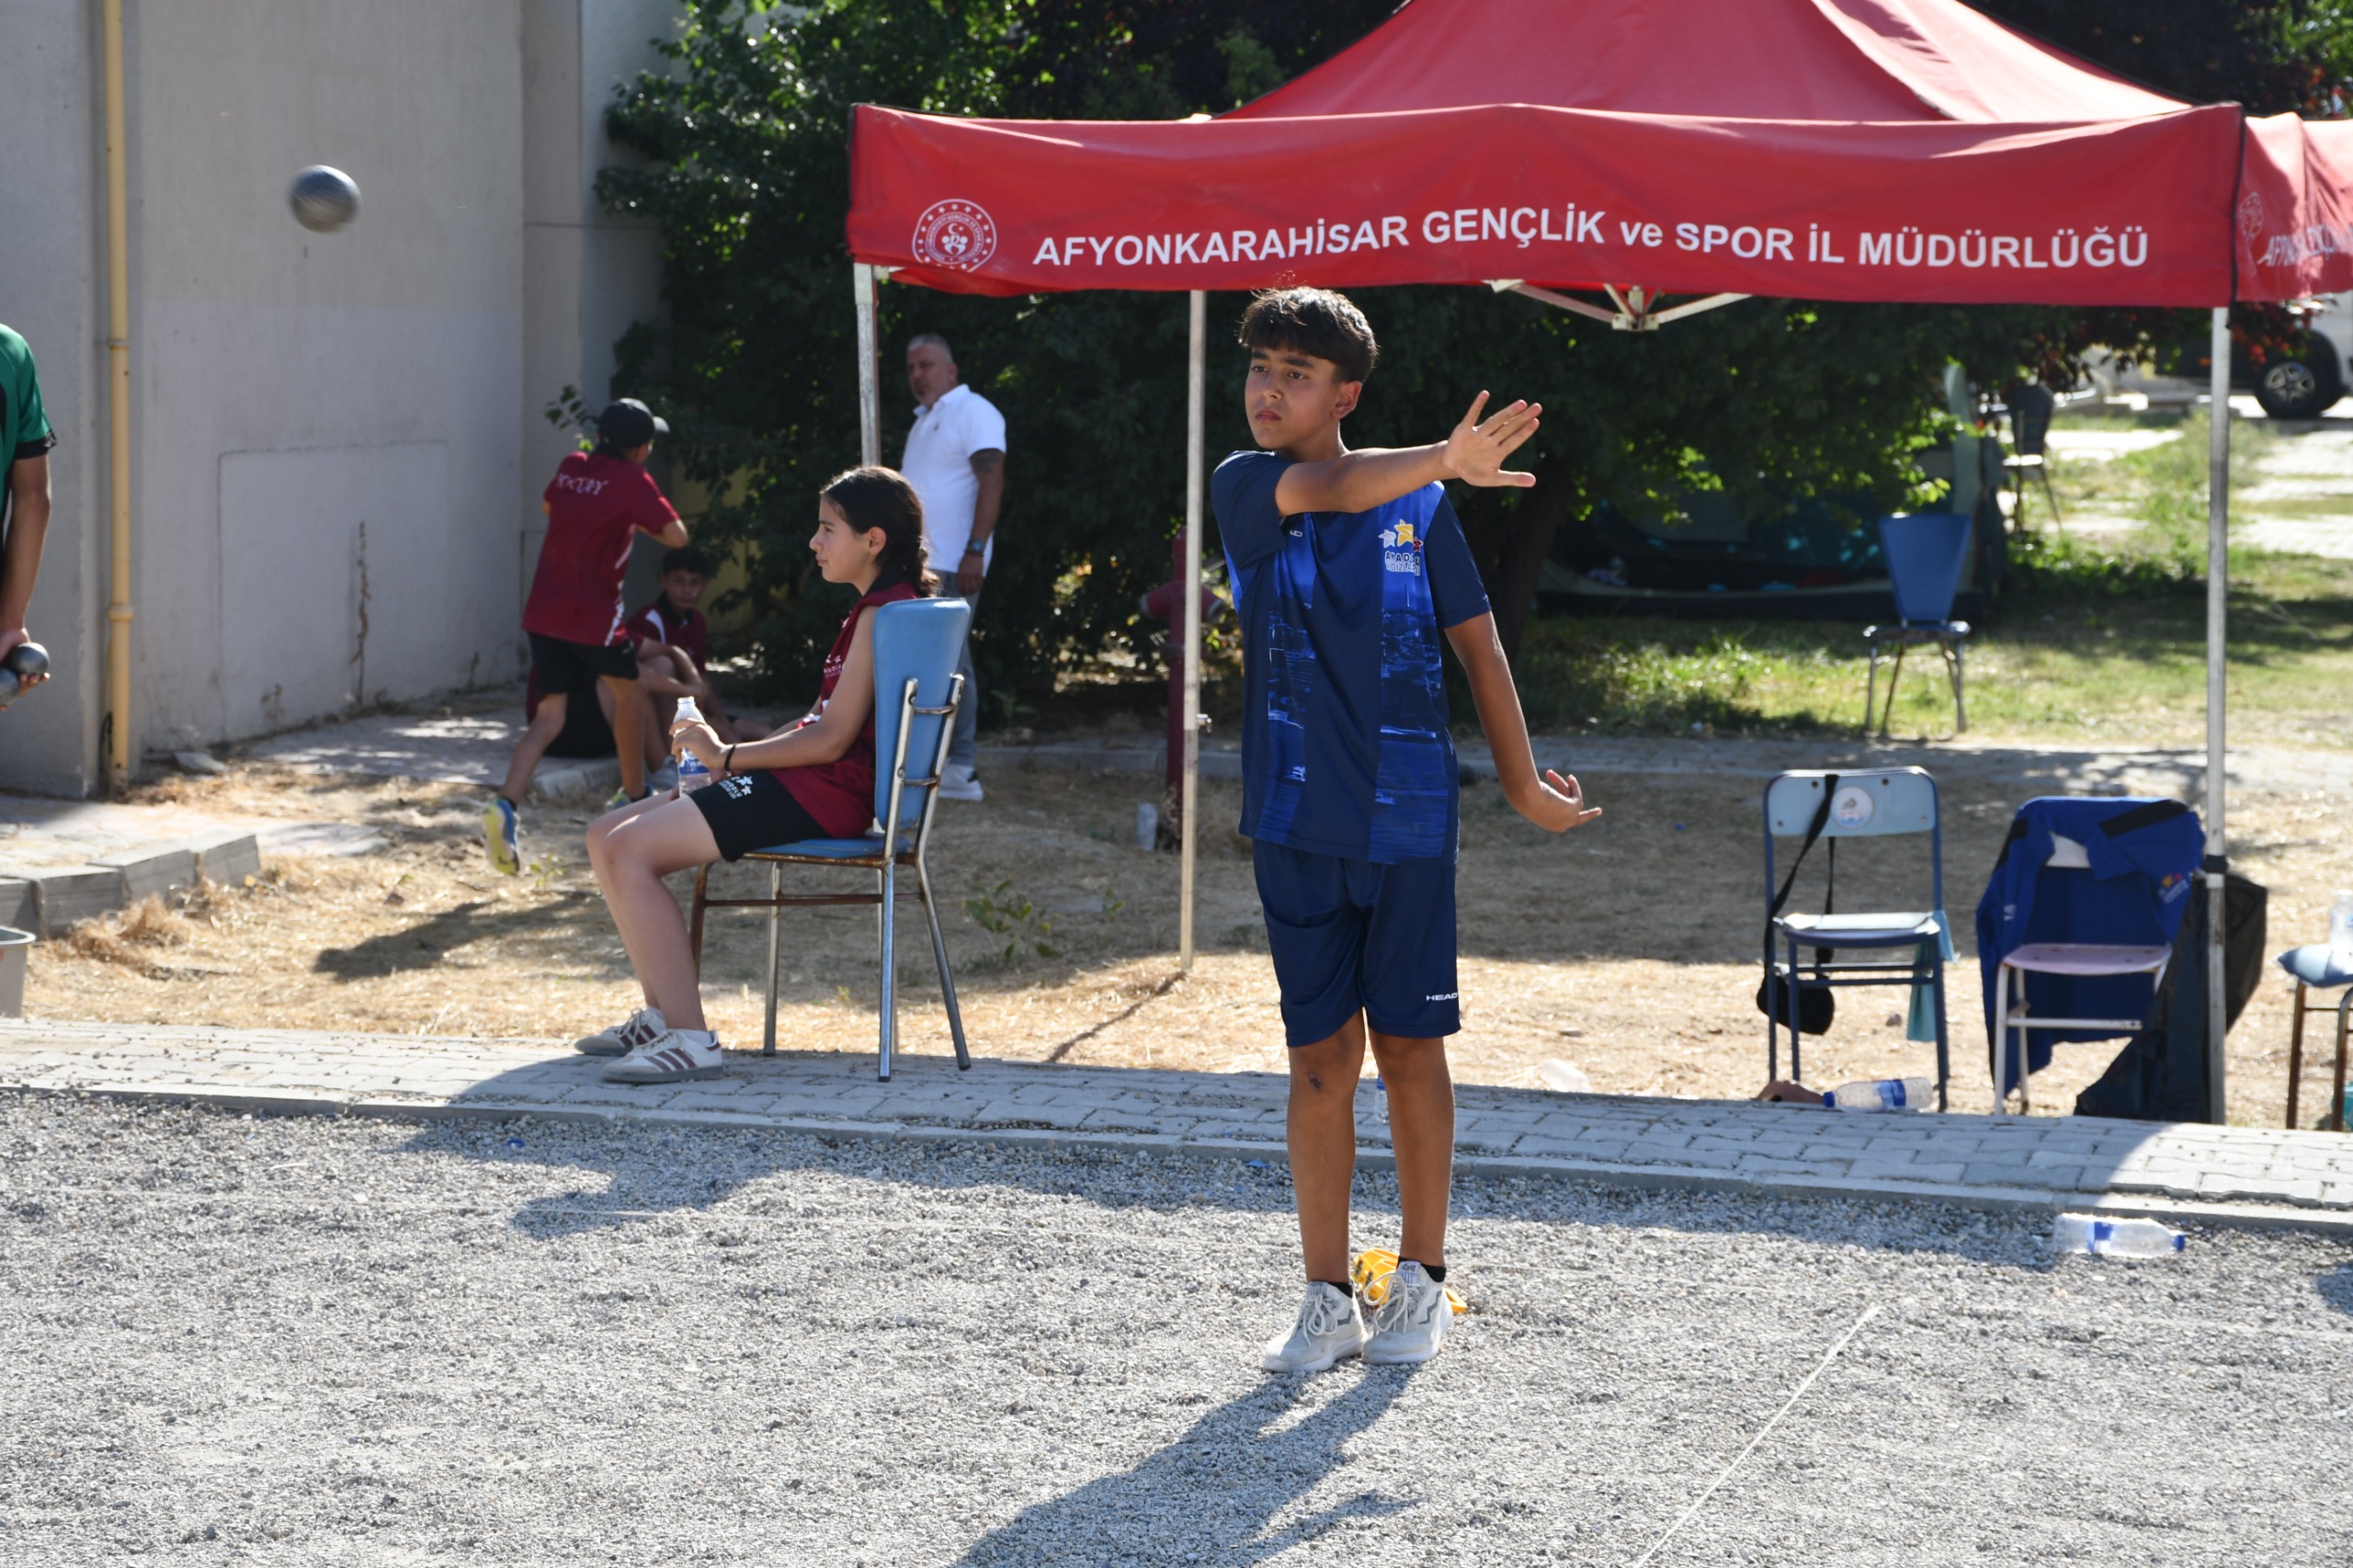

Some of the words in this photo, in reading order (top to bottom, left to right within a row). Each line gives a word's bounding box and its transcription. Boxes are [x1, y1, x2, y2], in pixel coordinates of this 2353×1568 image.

[1032, 215, 1410, 266] AFYONKARAHİSAR
[1421, 202, 1606, 248] GENÇLİK
[1620, 221, 1664, 247] ve
[1676, 222, 1794, 261] SPOR
[1808, 222, 1845, 264] İL
[1859, 225, 2148, 268] MÜDÜRLÜĞÜ
[1426, 992, 1458, 1002] HEAD
